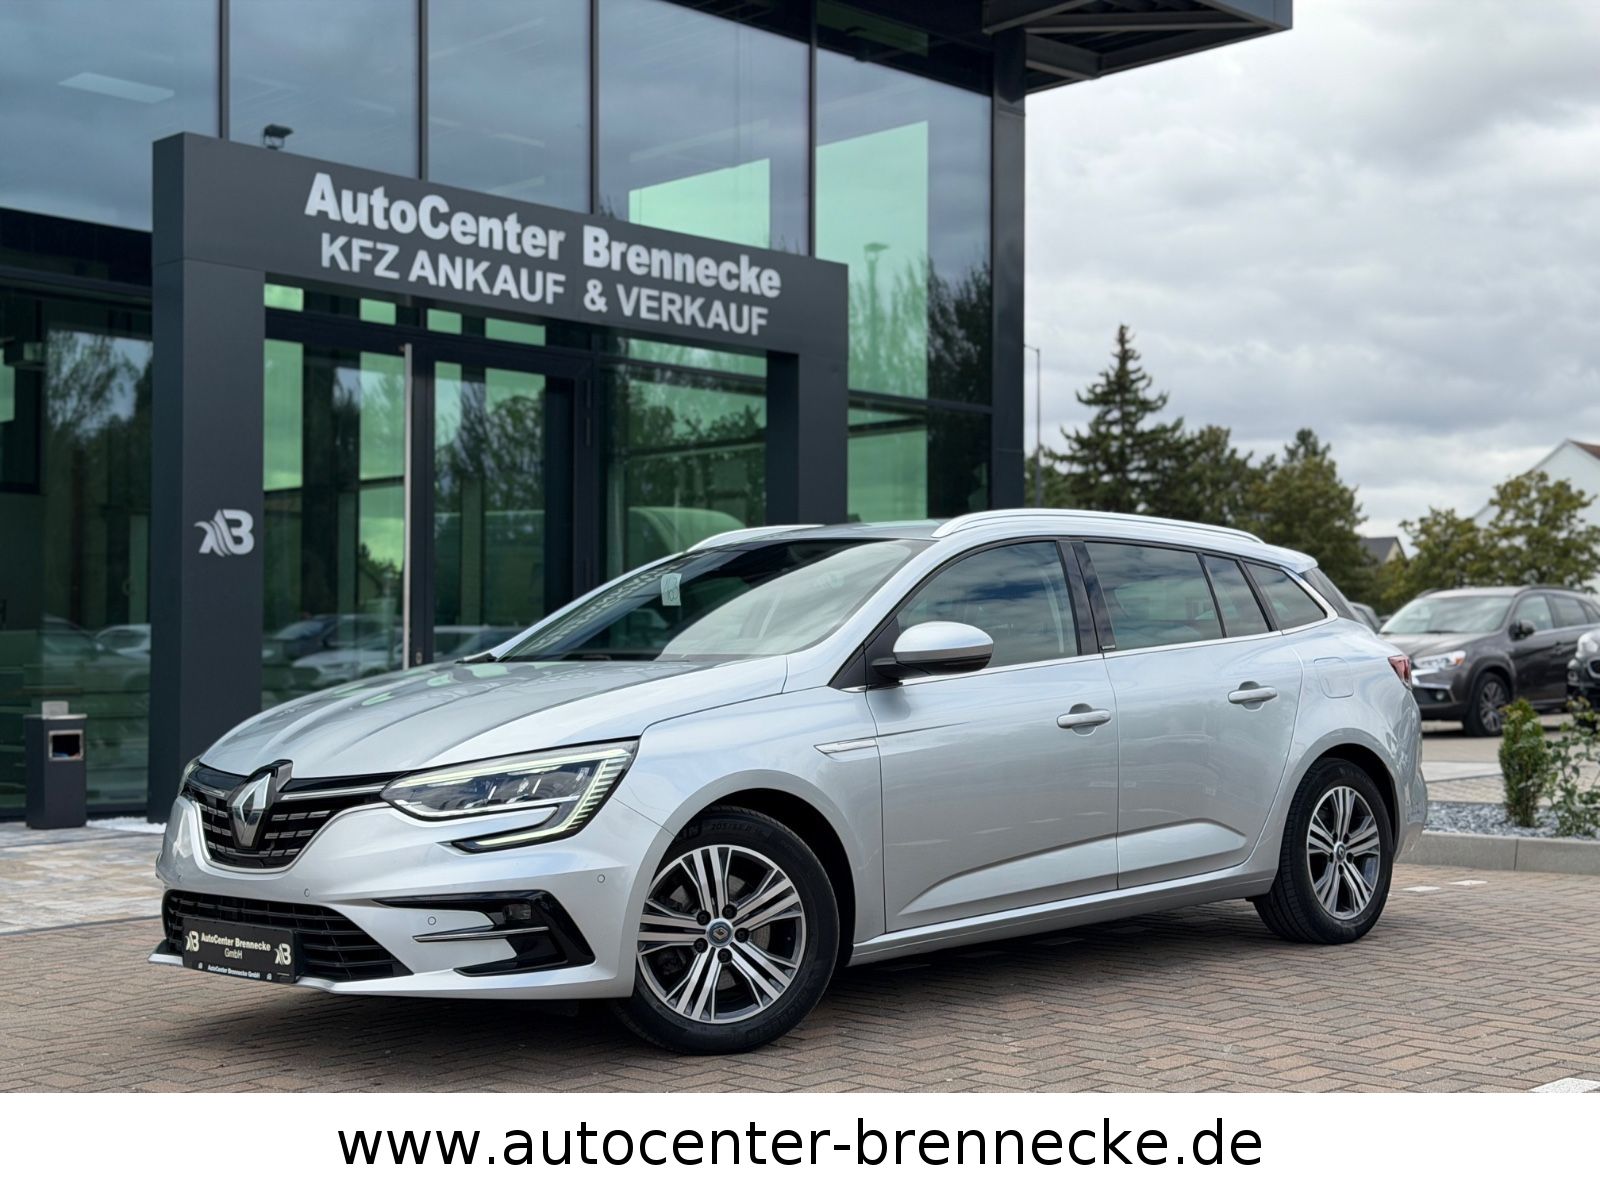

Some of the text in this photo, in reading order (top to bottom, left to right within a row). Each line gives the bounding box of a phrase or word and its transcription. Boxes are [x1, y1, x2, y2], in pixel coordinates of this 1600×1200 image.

[304, 172, 782, 298] AutoCenter Brennecke
[321, 233, 768, 336] KFZ ANKAUF & VERKAUF
[201, 932, 271, 951] AutoCenter Brennecke
[224, 948, 243, 959] GmbH
